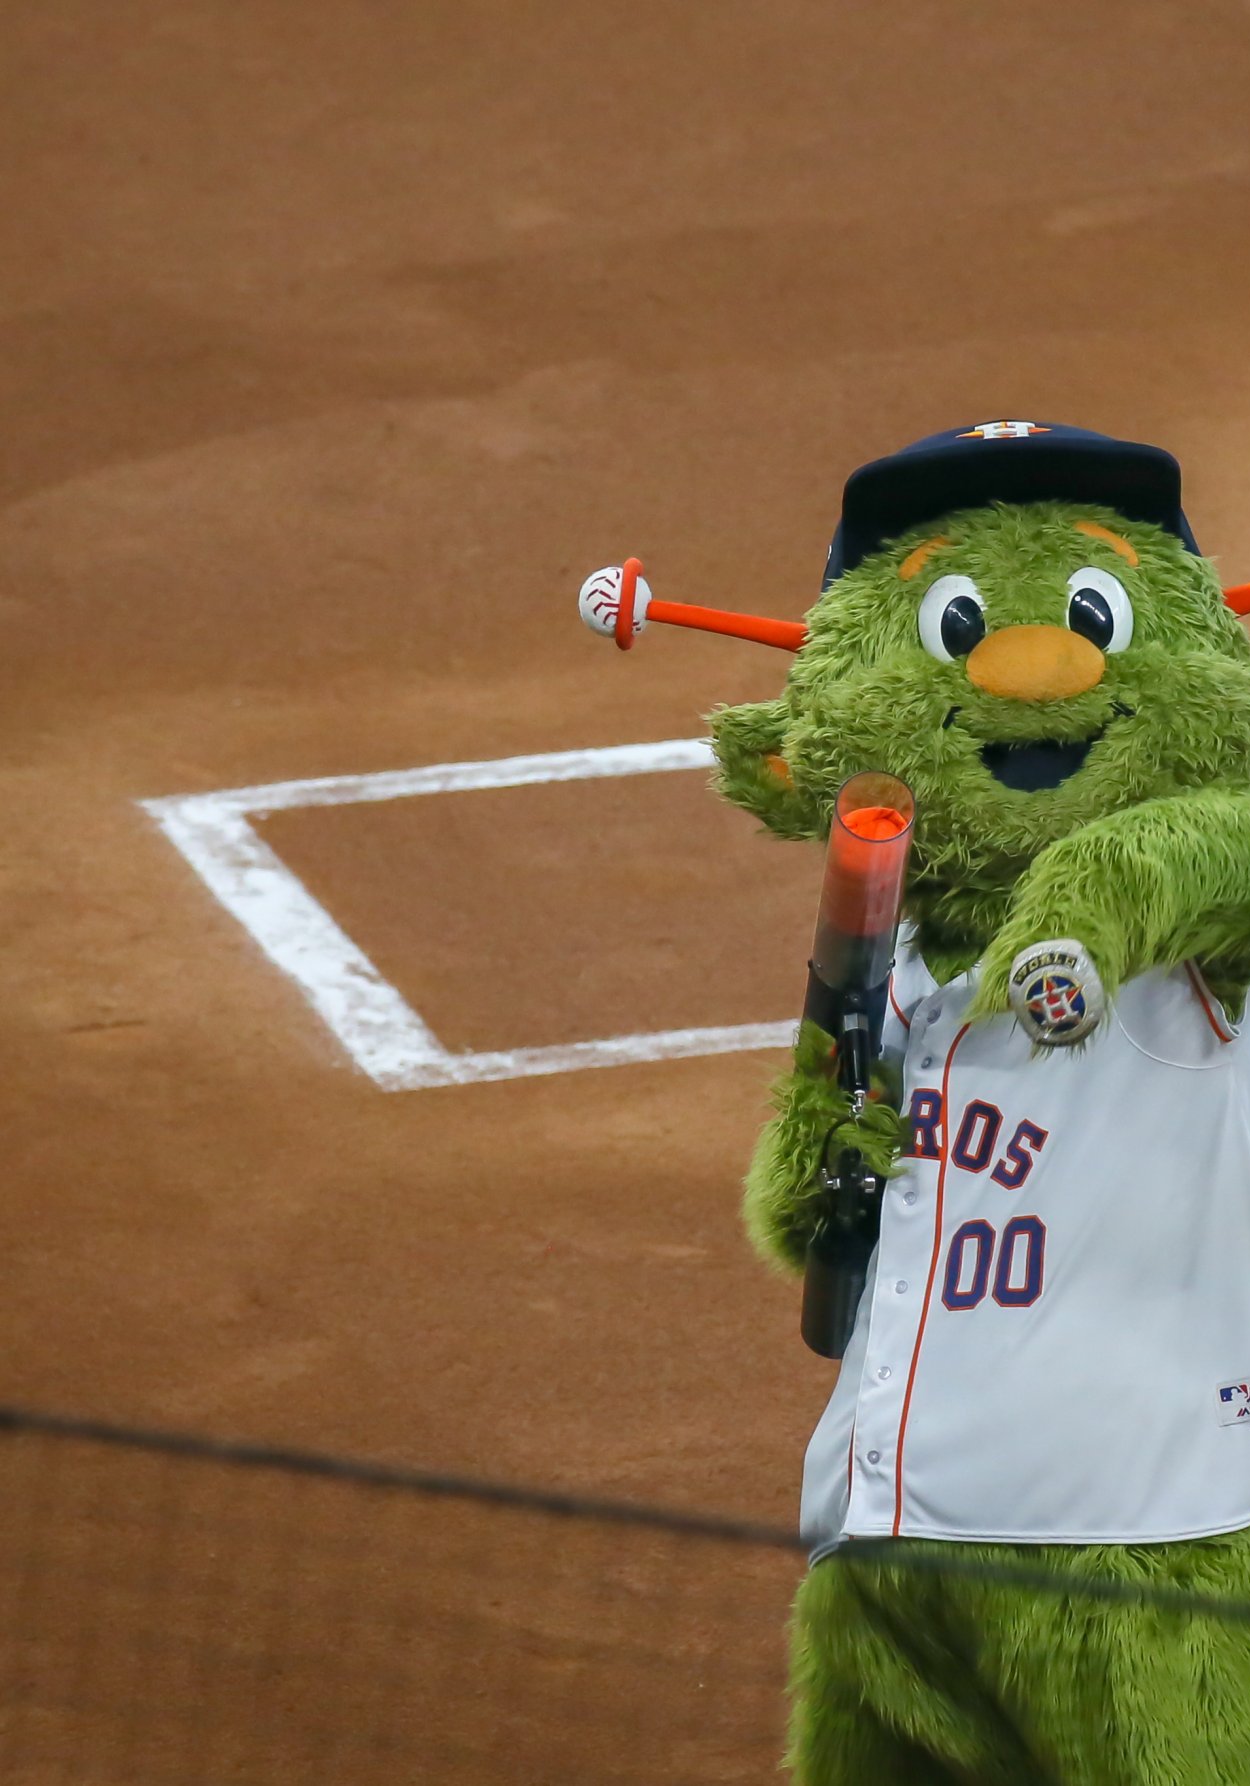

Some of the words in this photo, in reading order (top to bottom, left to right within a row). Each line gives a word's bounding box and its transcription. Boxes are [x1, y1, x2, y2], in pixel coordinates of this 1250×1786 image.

[1014, 951, 1075, 983] WORLD
[903, 1088, 1049, 1190] ROS
[942, 1215, 1046, 1311] 00
